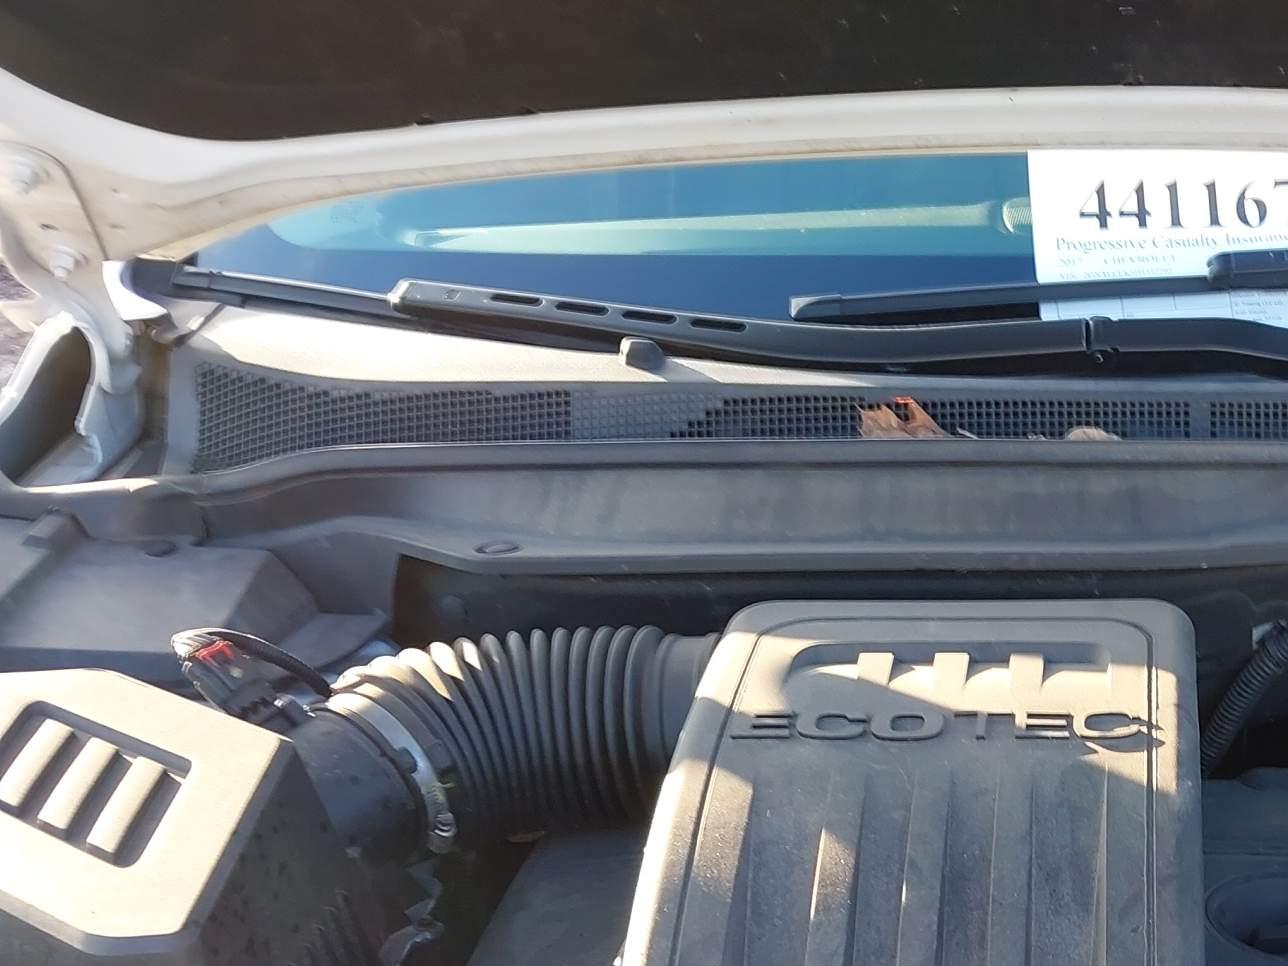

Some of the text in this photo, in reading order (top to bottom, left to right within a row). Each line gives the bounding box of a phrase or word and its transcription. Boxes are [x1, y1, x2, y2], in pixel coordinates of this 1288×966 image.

[1056, 237, 1147, 254] Progressive
[1152, 232, 1217, 250] Casualty
[730, 712, 1150, 741] ECOTEC
